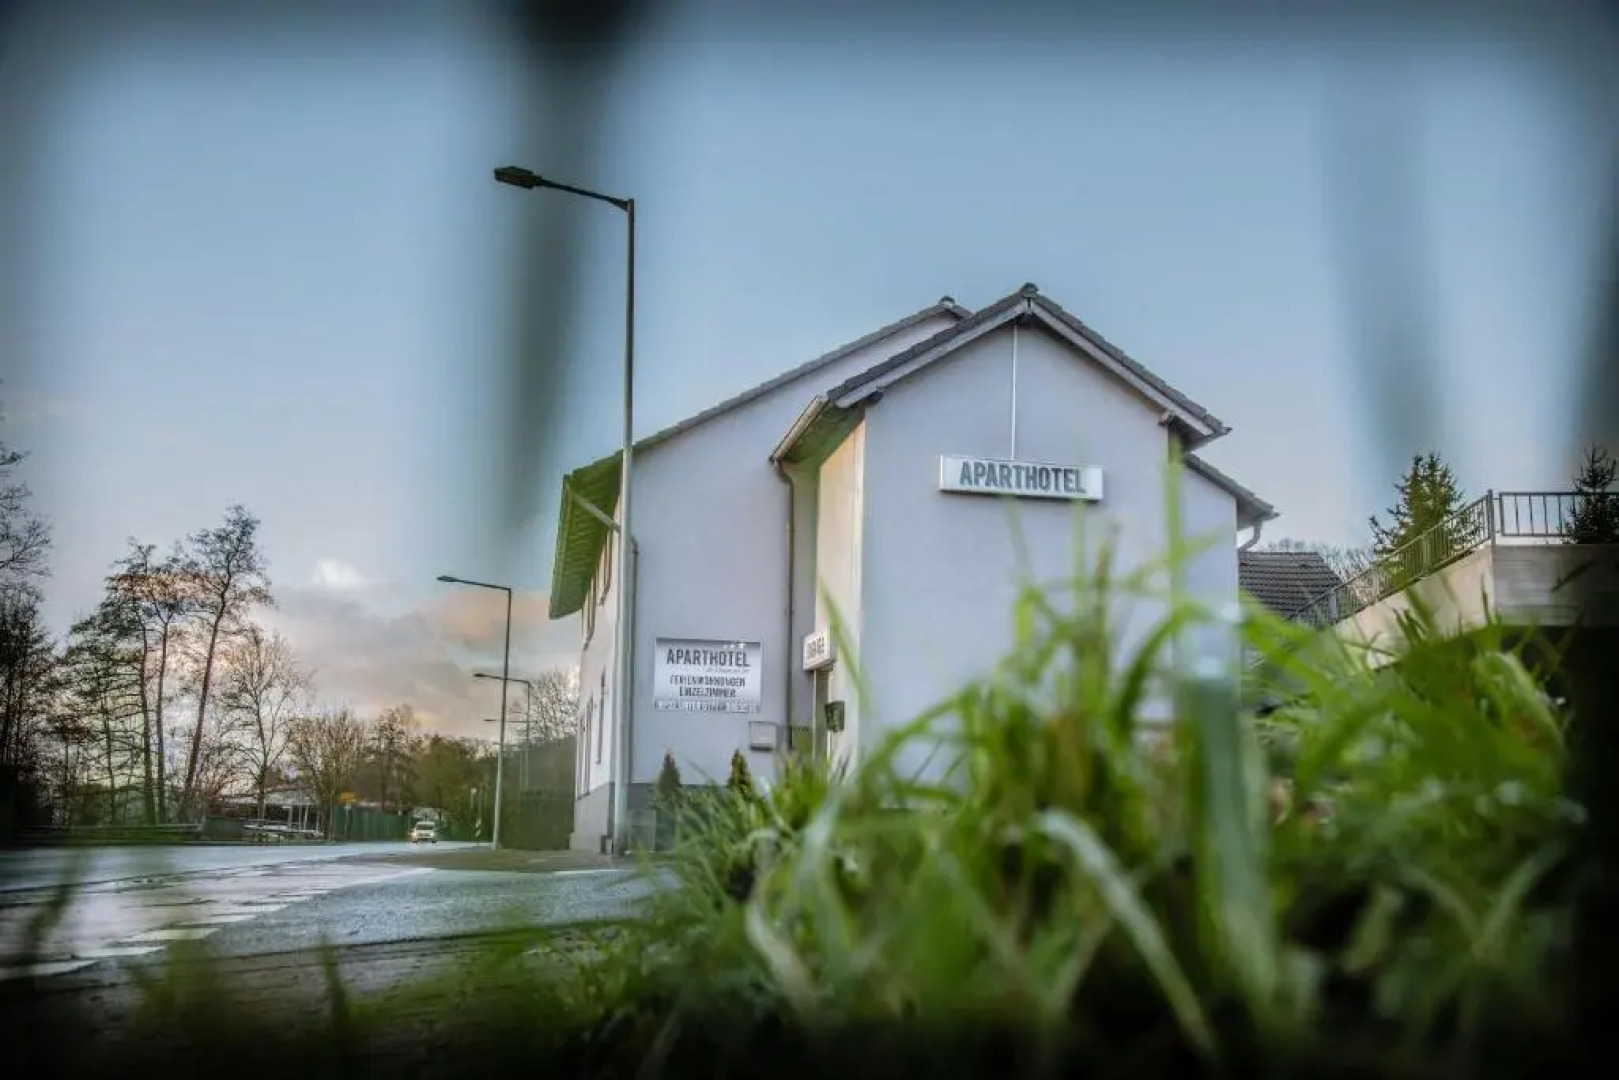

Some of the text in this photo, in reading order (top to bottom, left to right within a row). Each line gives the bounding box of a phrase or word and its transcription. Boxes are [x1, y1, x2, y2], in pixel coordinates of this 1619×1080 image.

[960, 460, 1086, 493] APARTHOTEL
[667, 648, 750, 667] APARTHOTEL
[670, 675, 746, 687] FERIENWOHNUNGEN
[680, 687, 736, 697] EINZELZIMMER
